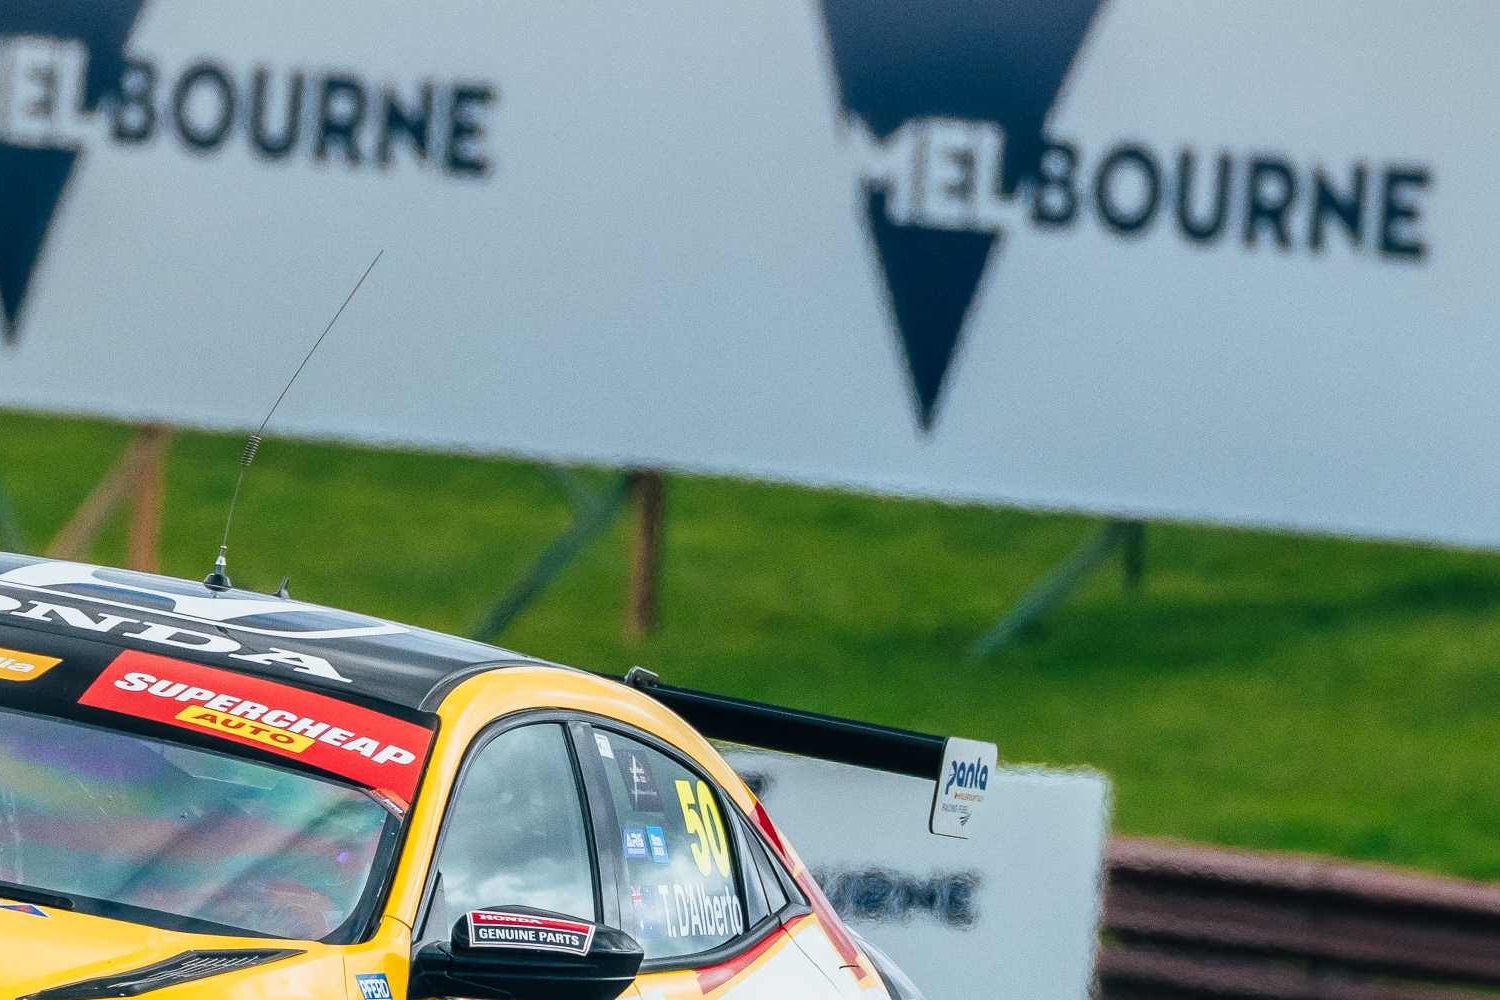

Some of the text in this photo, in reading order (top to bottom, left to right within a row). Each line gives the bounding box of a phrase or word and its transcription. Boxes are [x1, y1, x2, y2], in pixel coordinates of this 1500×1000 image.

[846, 114, 1434, 263] MELBOURNE
[113, 671, 416, 766] SUPERCHEAP
[192, 711, 297, 747] AUTO
[674, 780, 730, 878] 50
[479, 914, 543, 925] HONDA
[658, 885, 677, 937] T.
[478, 928, 580, 946] GENUINE PARTS
[360, 978, 390, 999] PFERD
